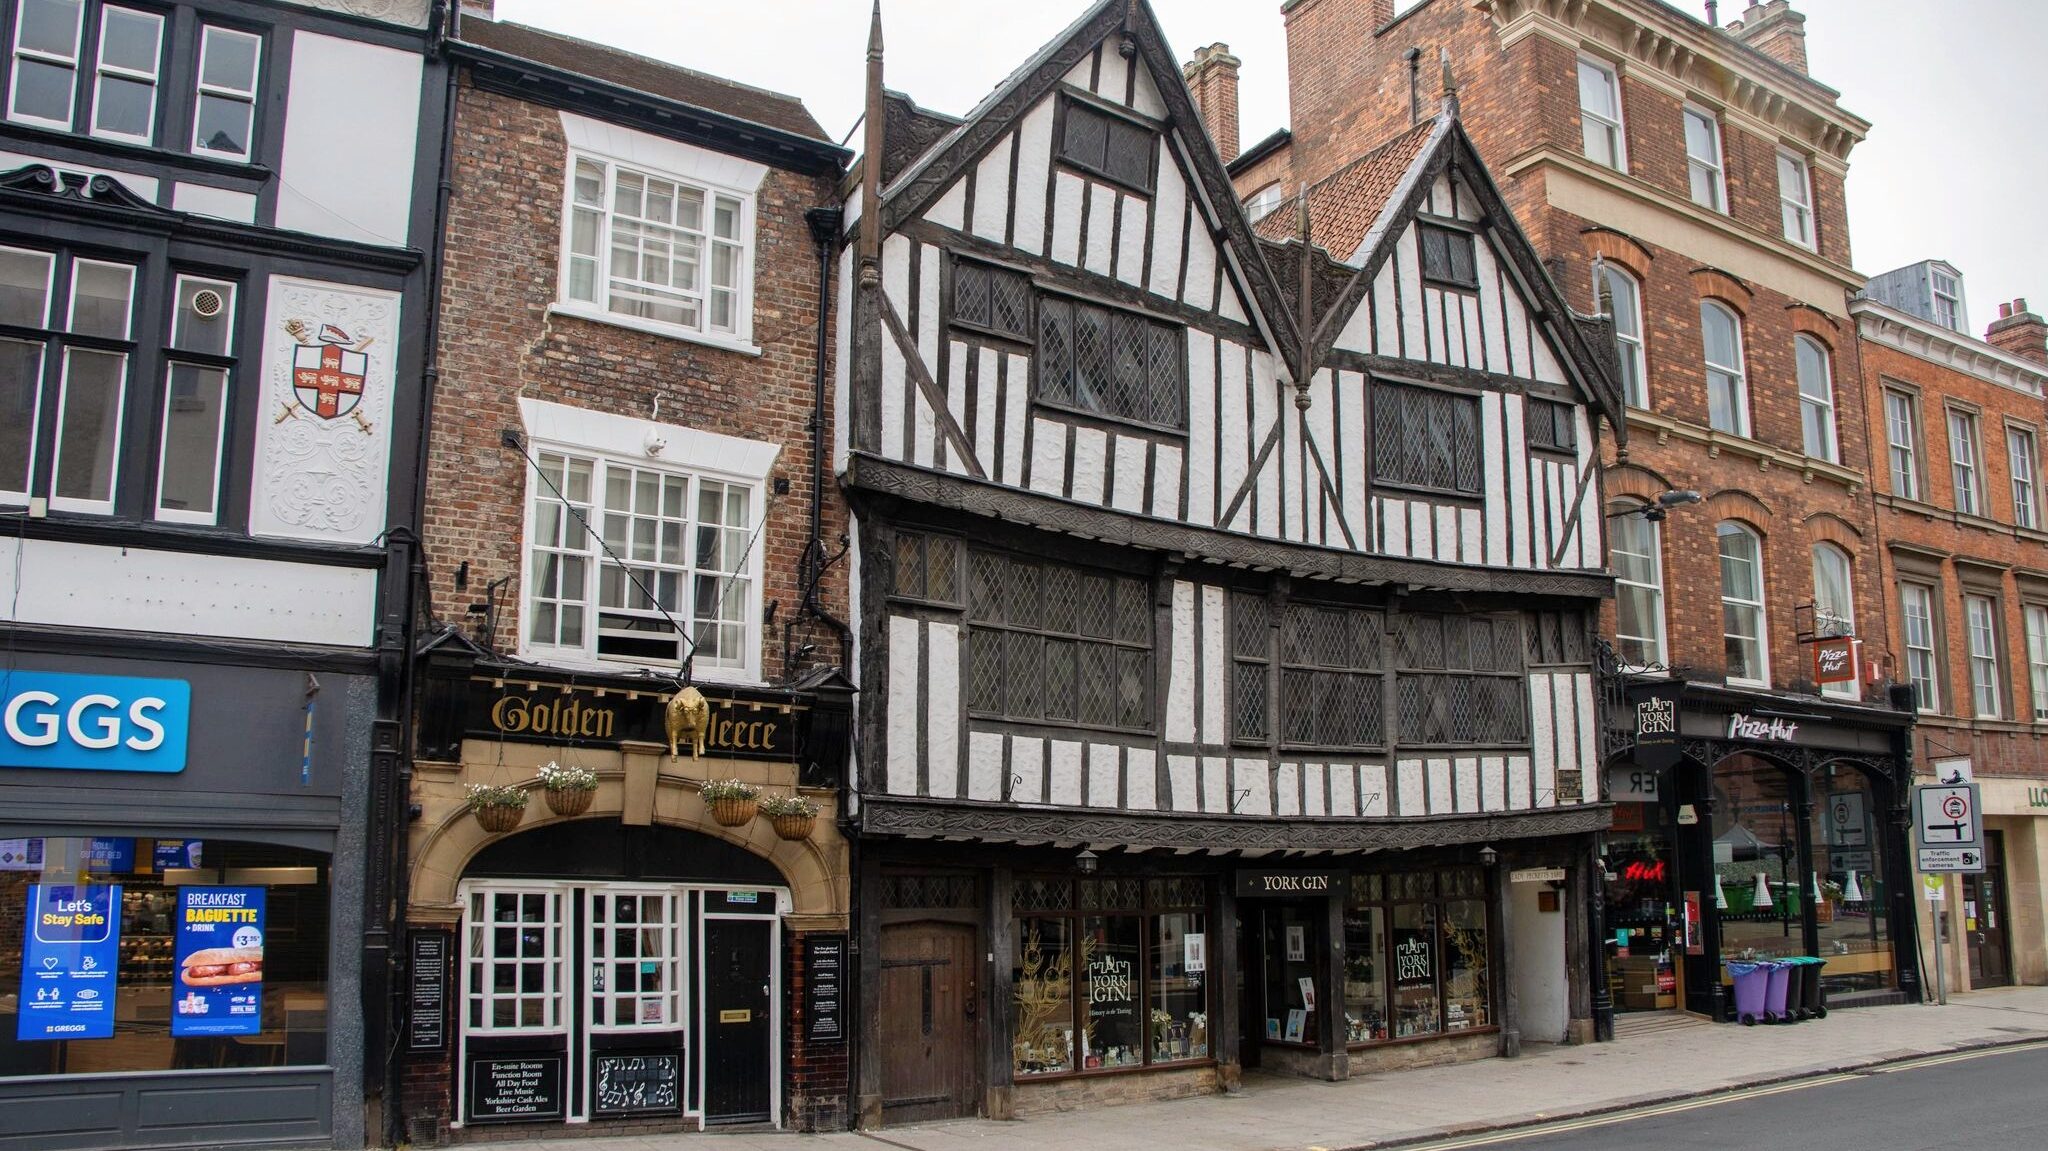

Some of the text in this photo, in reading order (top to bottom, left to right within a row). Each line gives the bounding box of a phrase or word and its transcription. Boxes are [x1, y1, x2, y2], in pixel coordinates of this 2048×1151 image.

[1818, 649, 1848, 662] Pizza
[1822, 660, 1845, 672] Hut
[4, 690, 166, 751] GGS
[491, 695, 614, 737] Golden
[1641, 711, 1671, 722] YORK
[1642, 720, 1670, 733] GIN
[1728, 712, 1798, 740] Pizza Hut
[1263, 875, 1328, 890] YORK GIN
[187, 893, 246, 906] BREAKFAST
[43, 913, 104, 927] Stay Safe
[186, 908, 258, 923] BAGUETTE
[192, 923, 215, 932] DRINK
[1400, 954, 1427, 966] YORK
[1401, 964, 1426, 978] GIN
[1093, 975, 1128, 988] YORK
[1094, 986, 1126, 1002] GIN
[55, 1024, 86, 1032] GREGGS
[491, 1063, 519, 1071] En-suite
[492, 1071, 520, 1079] Function
[507, 1080, 520, 1088] Day
[499, 1088, 513, 1096] Live
[485, 1097, 516, 1105] Yorkshire
[496, 1105, 511, 1113] Beer
